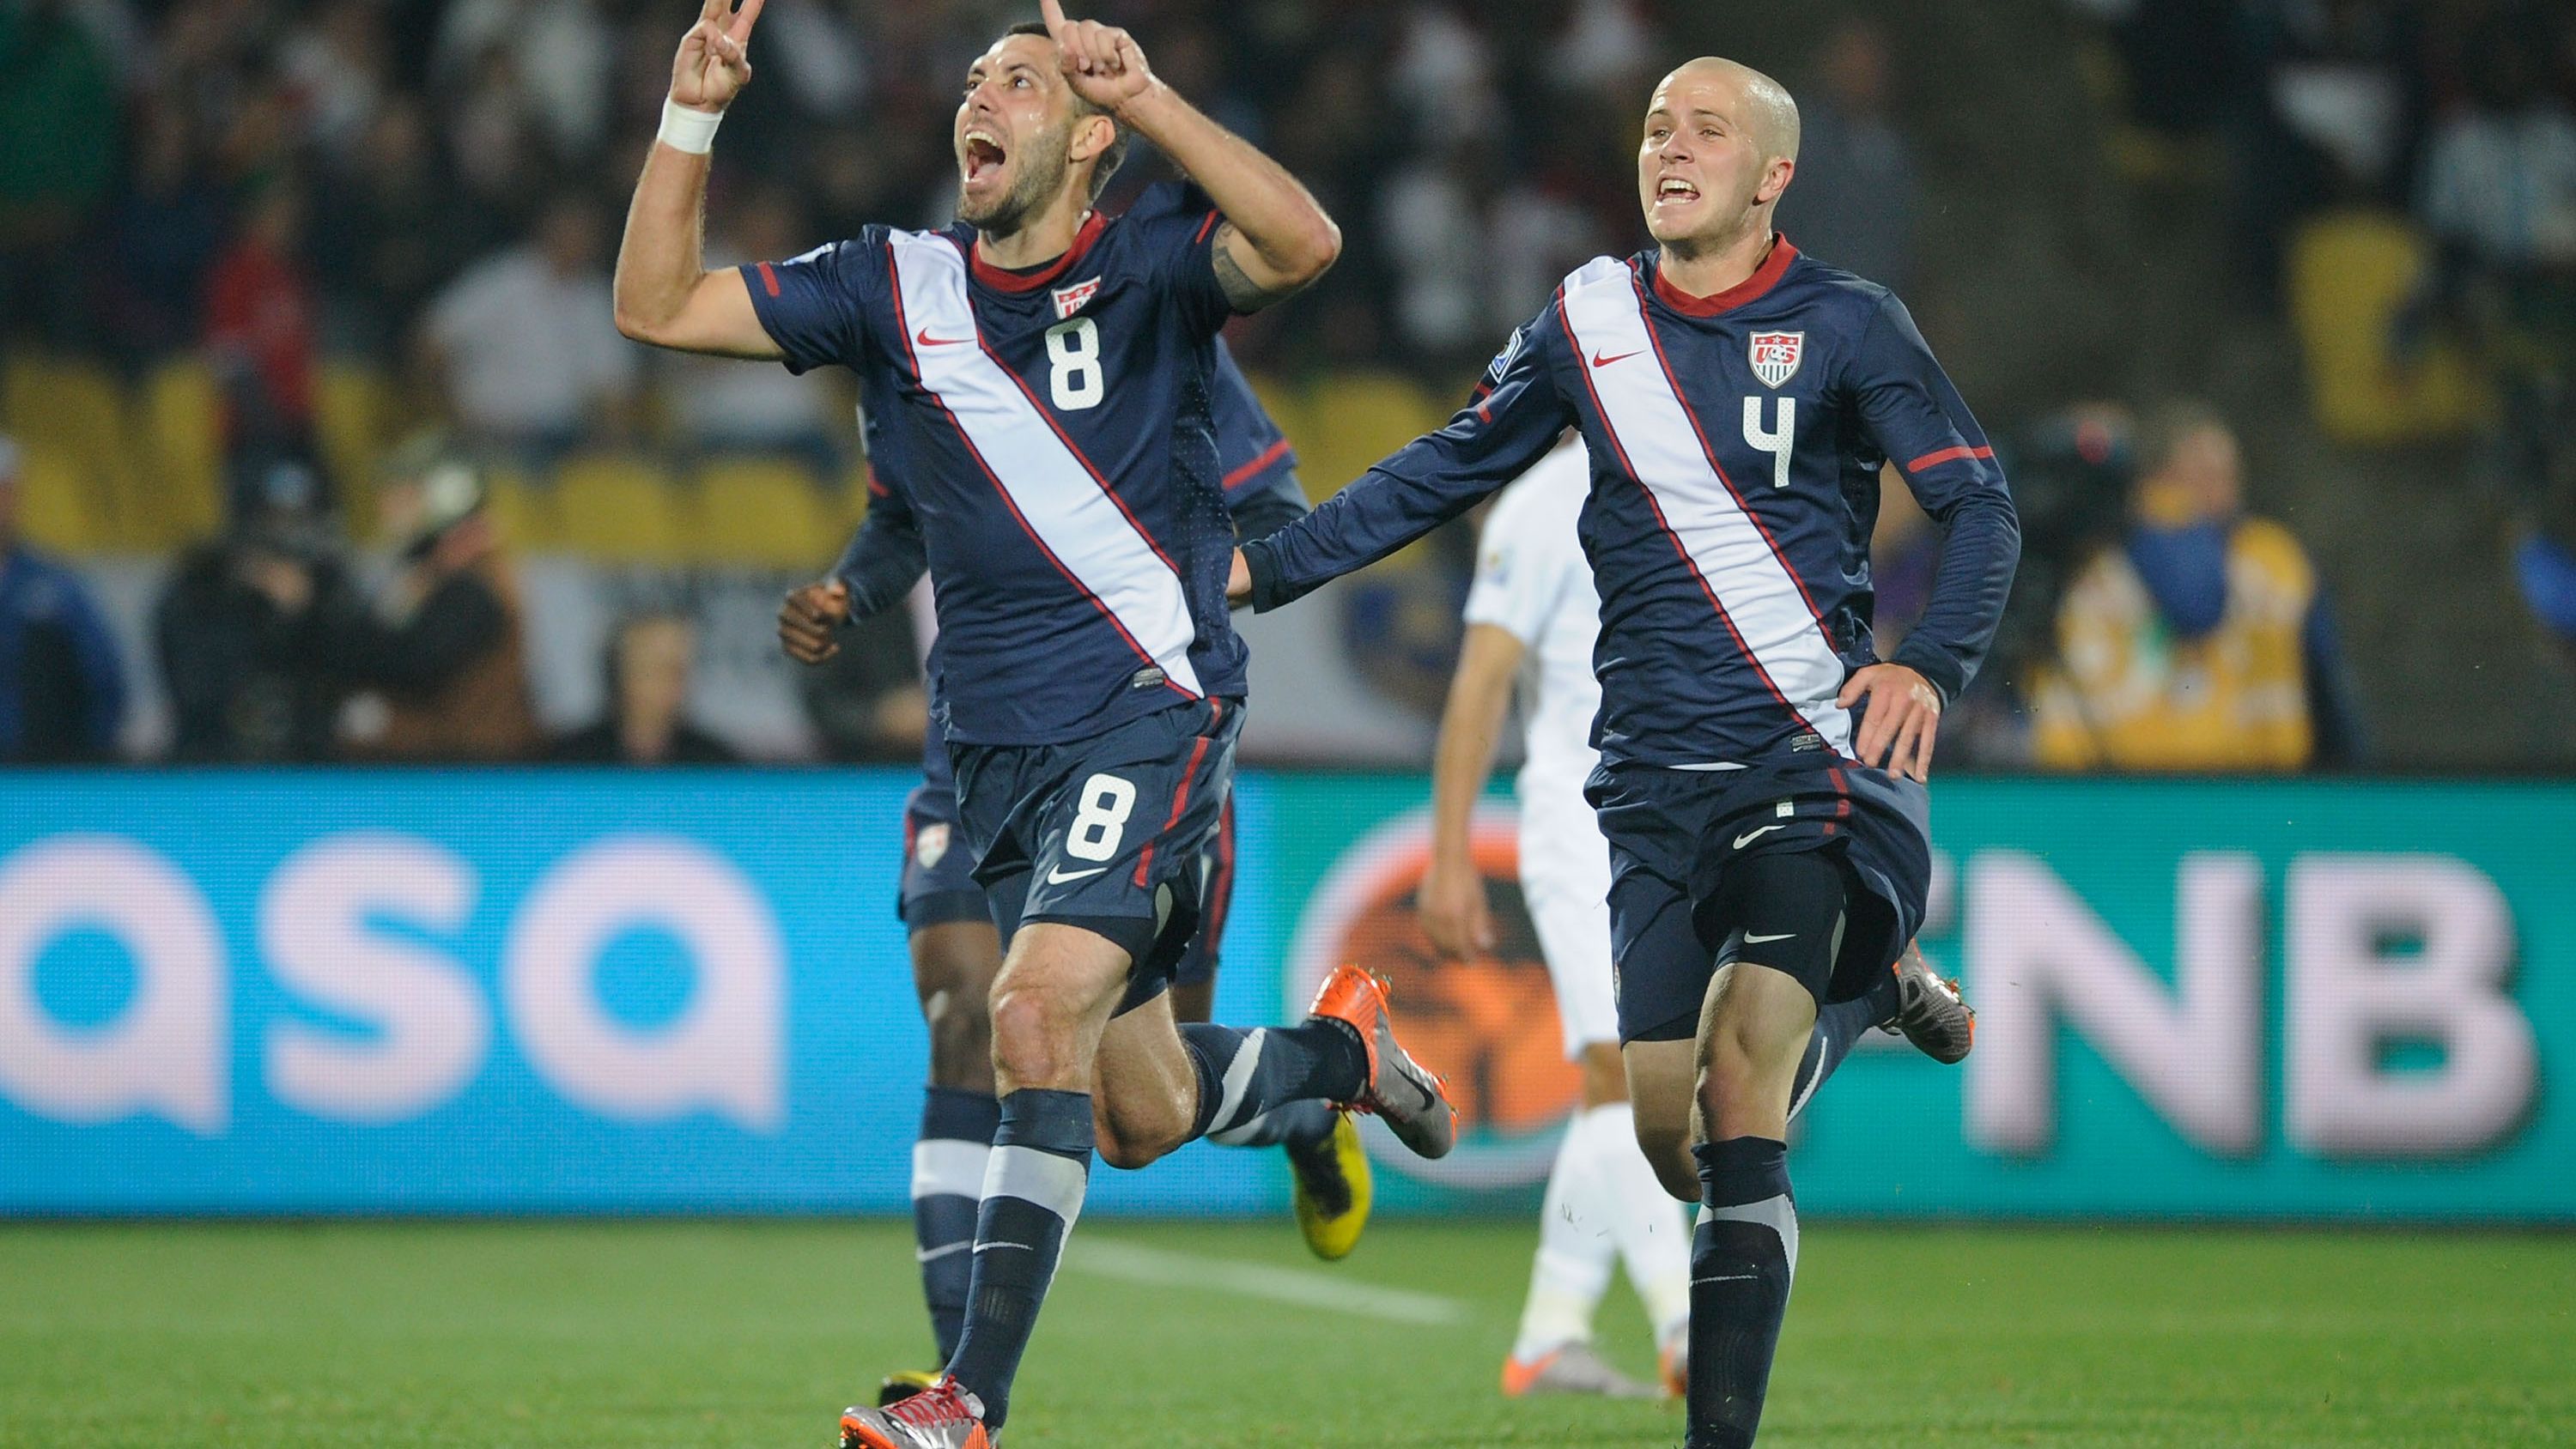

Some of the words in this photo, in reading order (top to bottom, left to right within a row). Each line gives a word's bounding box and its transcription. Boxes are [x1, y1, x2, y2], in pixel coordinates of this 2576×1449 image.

[1044, 317, 1104, 411] 8
[1743, 397, 1795, 488] 4
[1066, 773, 1138, 862] 8
[0, 829, 788, 1137] asa
[1902, 850, 2540, 1157] NB
